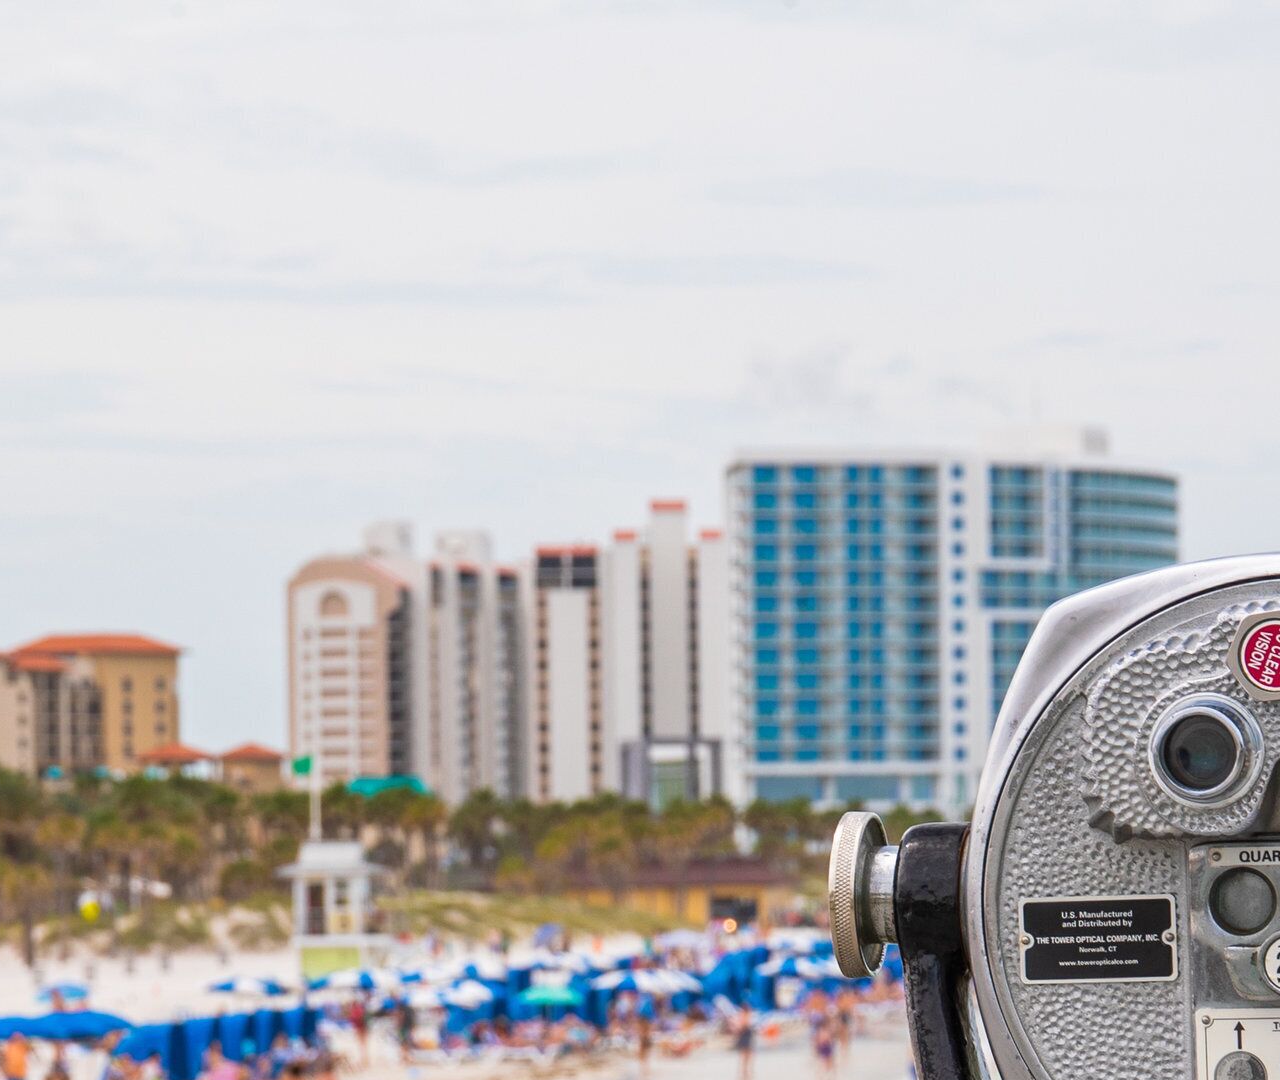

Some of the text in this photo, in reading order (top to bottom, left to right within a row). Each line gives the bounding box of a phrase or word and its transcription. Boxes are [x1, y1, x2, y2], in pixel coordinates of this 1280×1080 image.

[1247, 631, 1274, 670] VISION
[1061, 910, 1133, 919] U.S. Manufactured
[1062, 919, 1133, 928] and Distributed by
[1036, 933, 1160, 945] THE TOWER OPTICAL COMPANY, INC.
